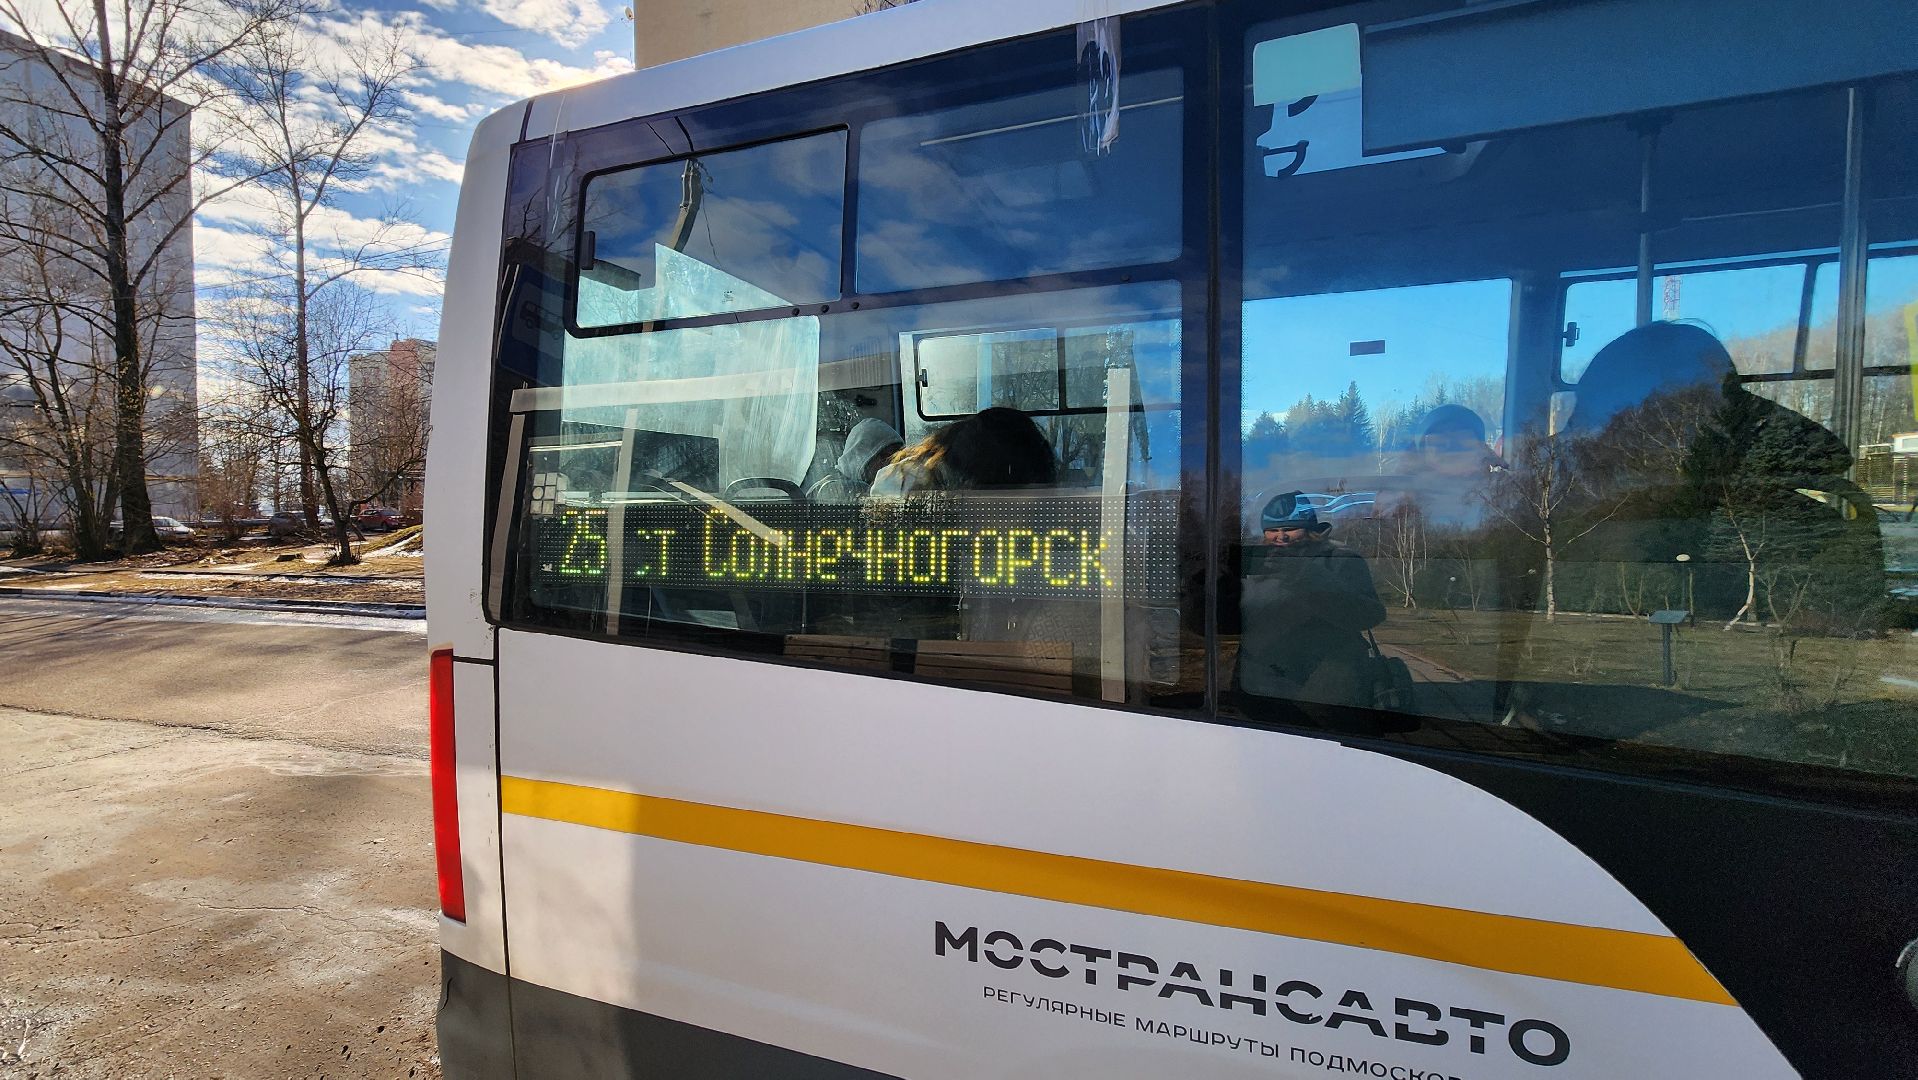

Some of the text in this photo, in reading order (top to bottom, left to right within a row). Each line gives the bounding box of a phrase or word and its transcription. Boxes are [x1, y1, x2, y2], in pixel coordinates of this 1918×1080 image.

[559, 509, 608, 575] 25
[934, 920, 1571, 1067] МОСТРАНСАВТО
[983, 985, 1463, 1080] РЕГУЛЯРНЫЕ МАРШРУТЫ ПОДМОСК
